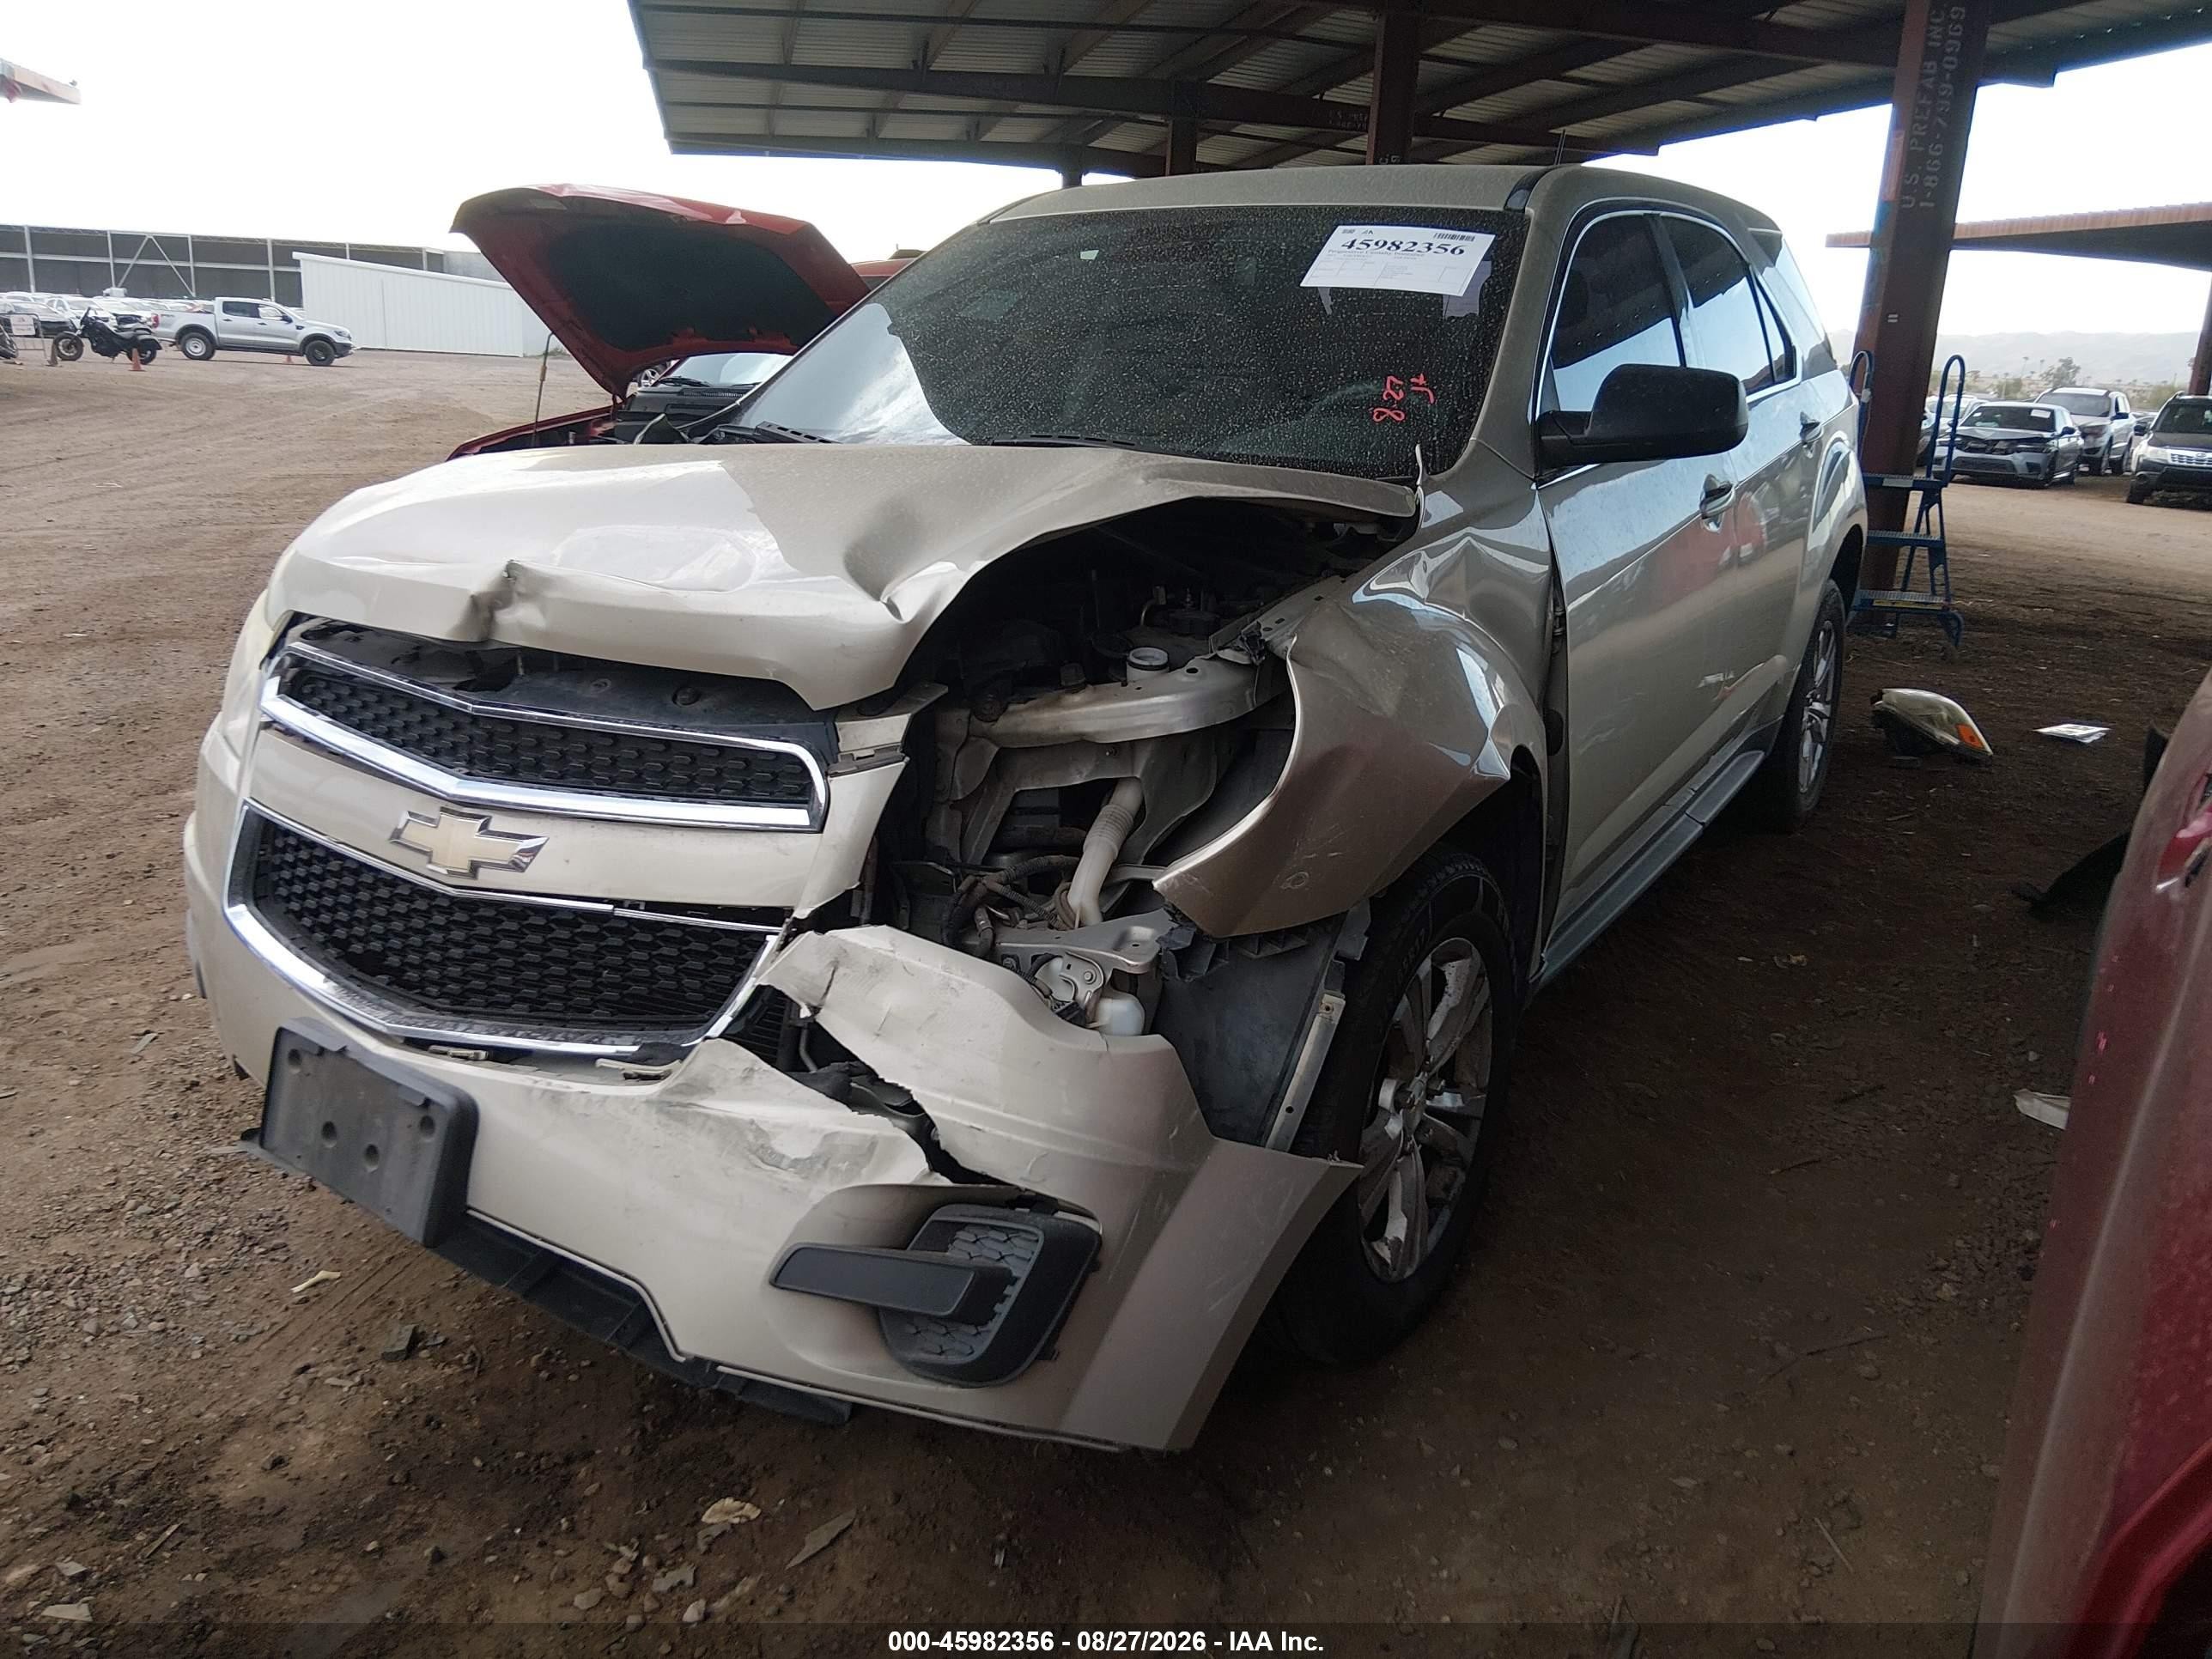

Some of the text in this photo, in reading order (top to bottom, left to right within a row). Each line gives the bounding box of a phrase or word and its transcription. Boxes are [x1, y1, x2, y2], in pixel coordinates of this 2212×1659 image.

[1911, 60, 1937, 151] PREFAB
[1920, 6, 1966, 207] 1-866-799-0969
[1341, 239, 1468, 256] 45982356
